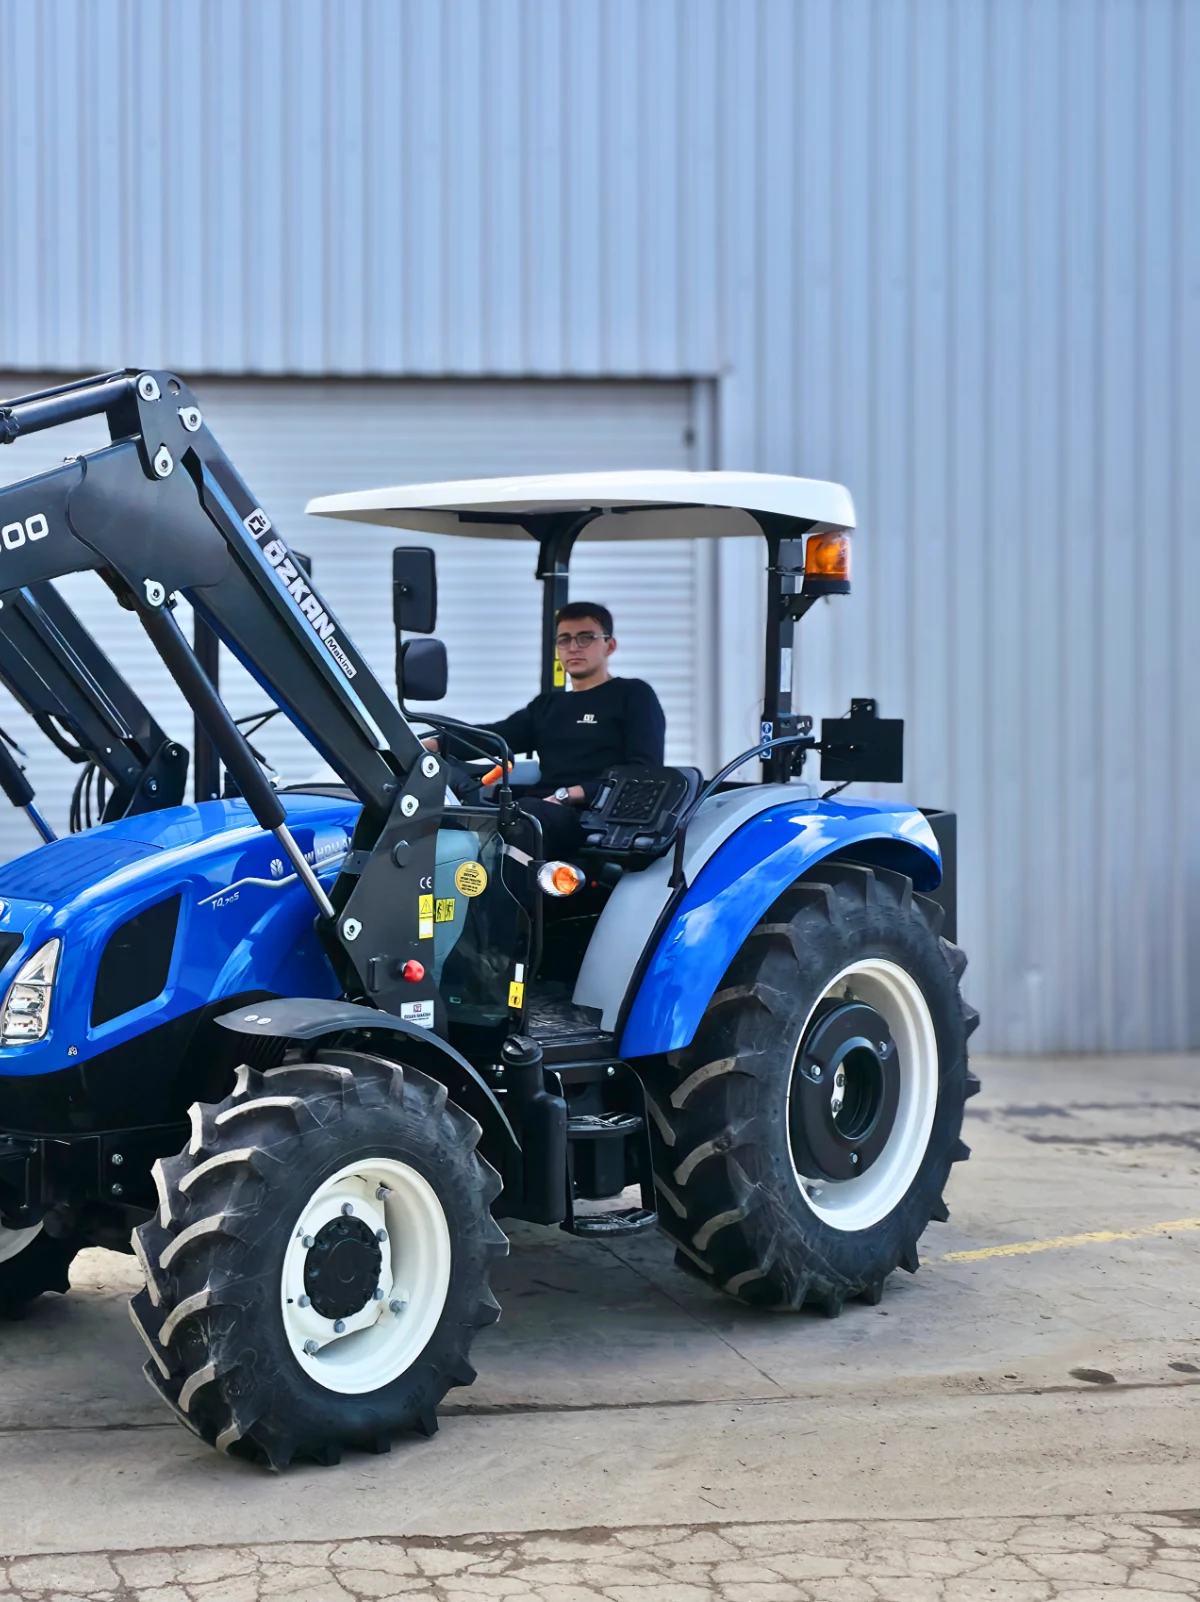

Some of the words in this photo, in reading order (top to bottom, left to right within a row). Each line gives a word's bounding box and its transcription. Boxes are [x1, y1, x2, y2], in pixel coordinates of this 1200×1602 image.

[263, 539, 336, 641] ÖZKAN
[327, 639, 354, 677] Makina
[420, 876, 433, 889] CE
